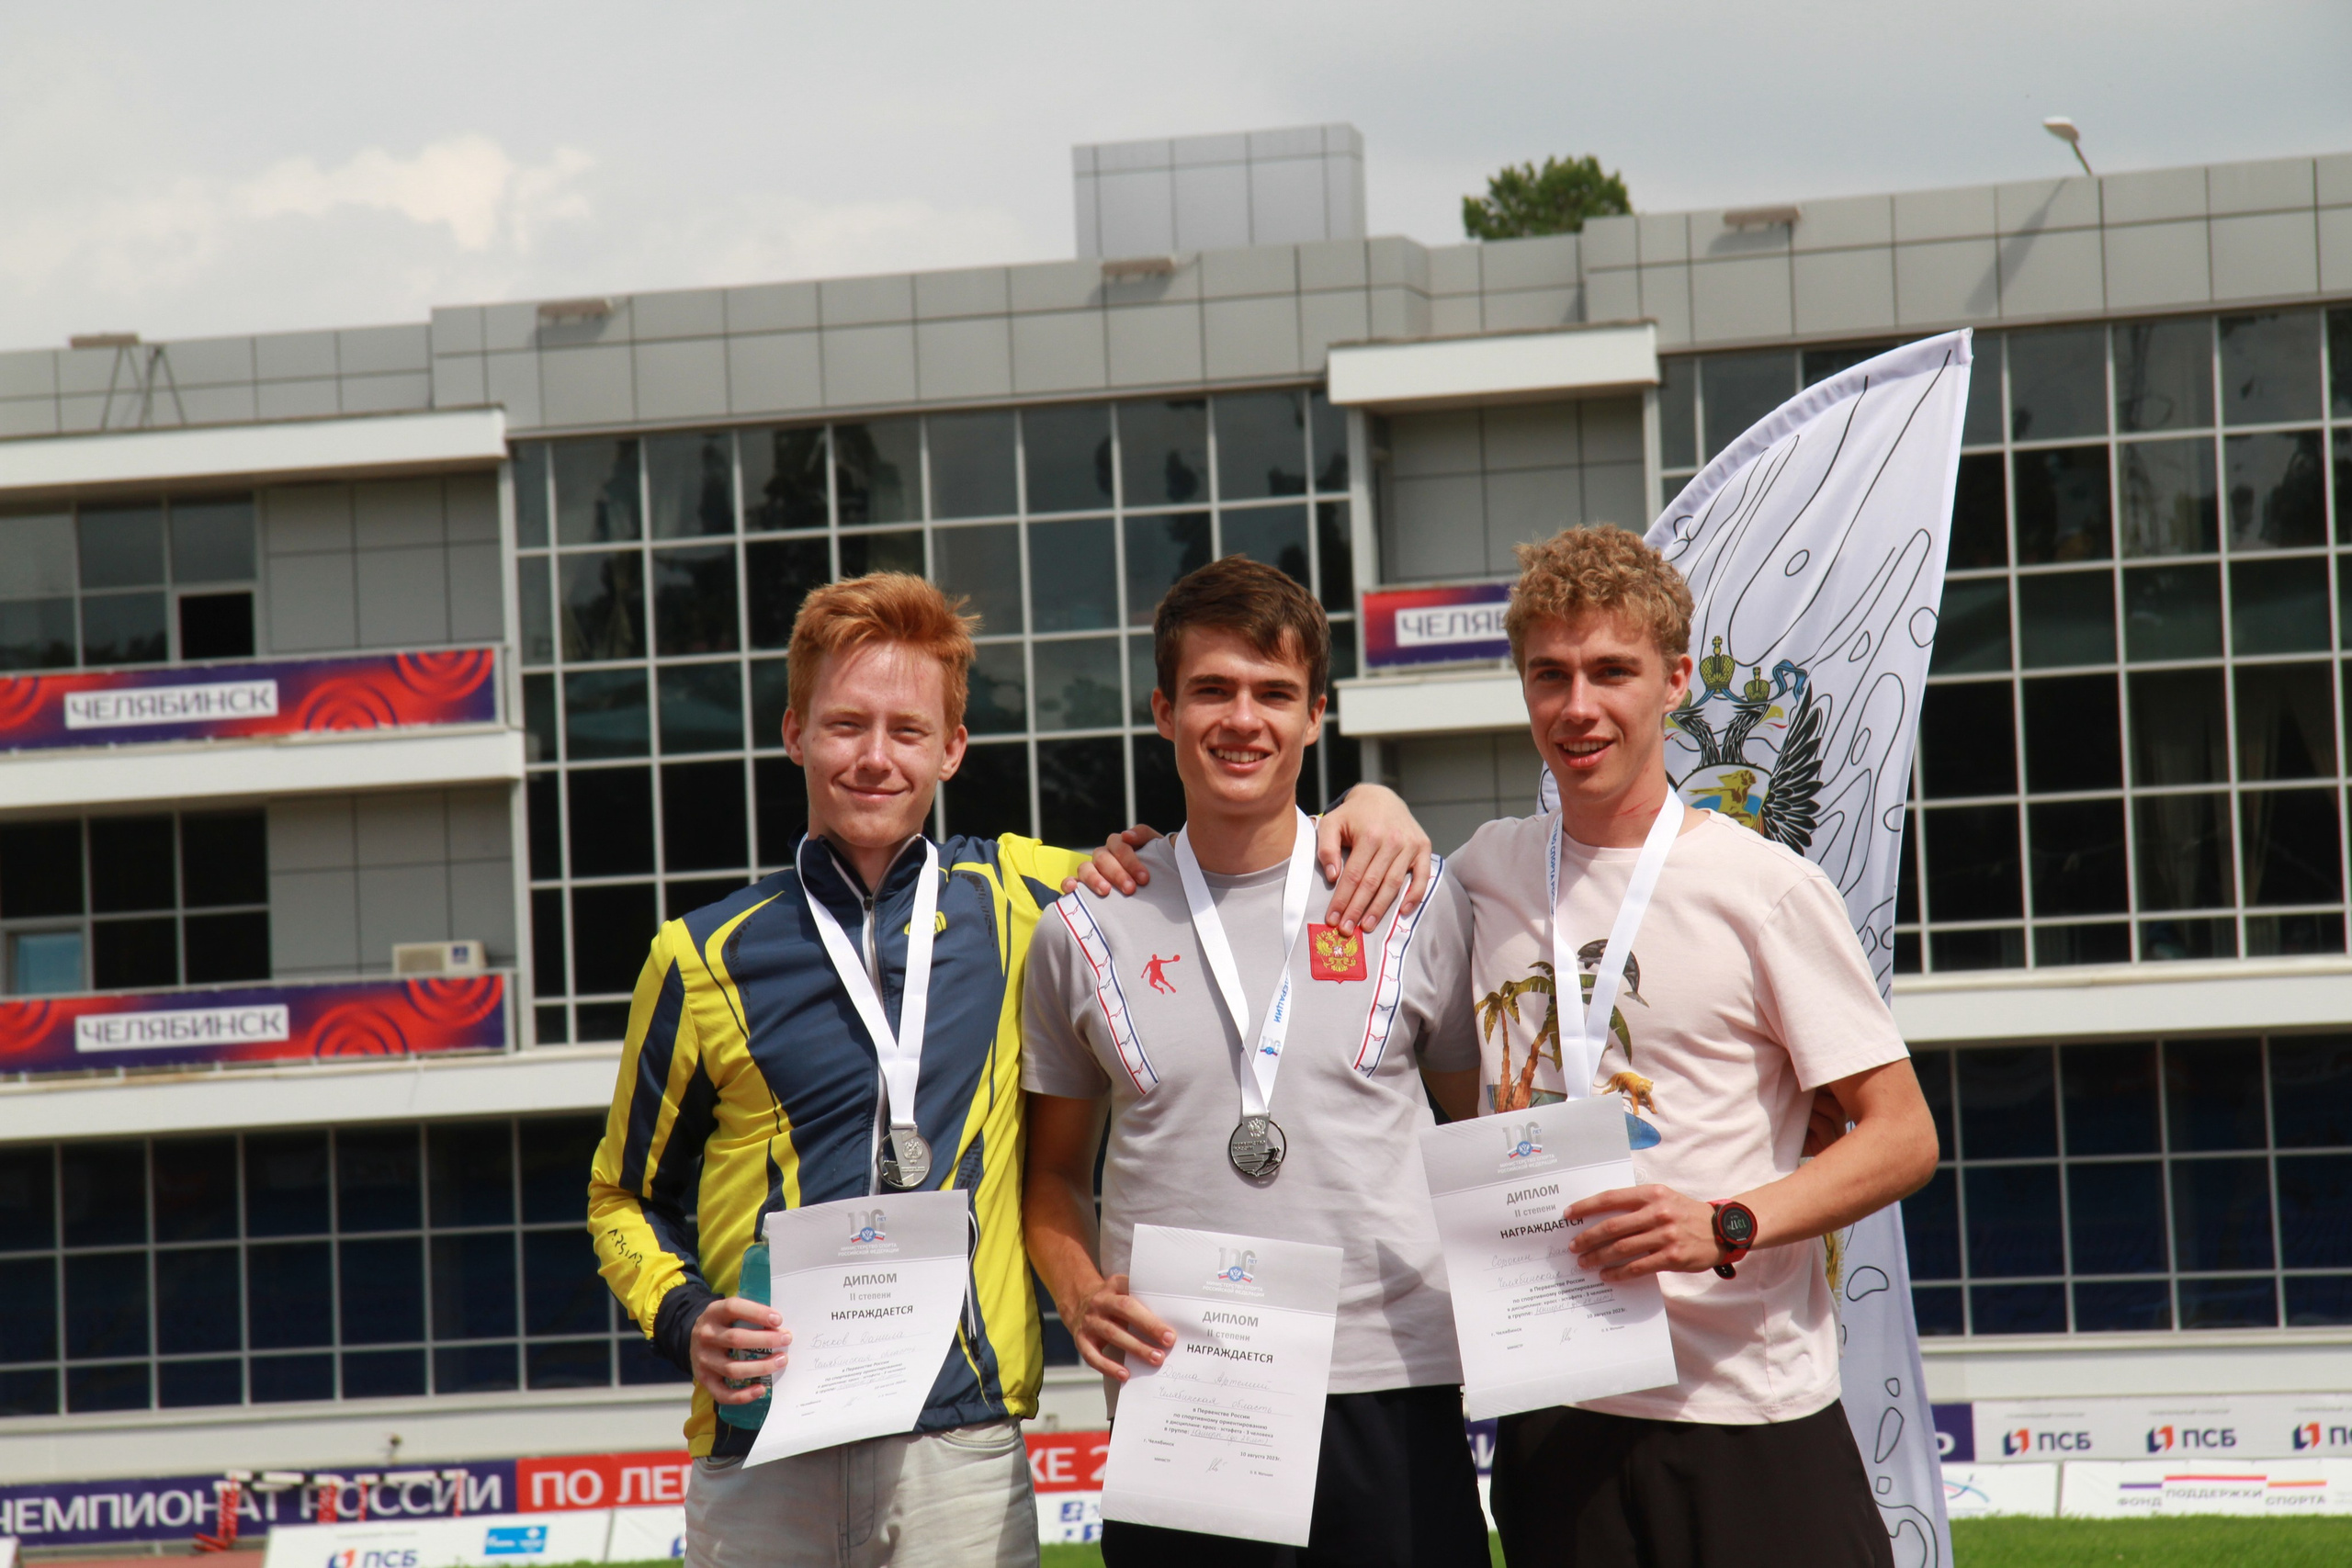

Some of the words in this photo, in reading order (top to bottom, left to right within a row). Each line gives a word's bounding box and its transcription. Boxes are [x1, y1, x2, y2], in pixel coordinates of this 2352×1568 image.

[70, 684, 273, 721] ЧЕЛЯБИНСК
[82, 1010, 284, 1044] ЧЕЛЯБИНСК
[1507, 1184, 1560, 1205] ДИПЛОМ
[1522, 1204, 1556, 1216] степени
[1499, 1218, 1584, 1239] НАГРАЖДАЕТСЯ
[843, 1273, 898, 1288] ДИПЛОМ
[858, 1292, 891, 1301] степени
[831, 1304, 913, 1321] НАГРАЖДАЕТСЯ
[1203, 1311, 1259, 1327] ДИПЛОМ
[1216, 1331, 1250, 1342] степени
[1187, 1343, 1274, 1364] НАГРАЖДАЕТСЯ
[1197, 1407, 1229, 1417] Первенстве
[1182, 1415, 1218, 1425] спортивному
[1219, 1420, 1268, 1430] ориентированию
[2038, 1430, 2091, 1450] ПСБ
[2183, 1427, 2236, 1448] ПСБ
[531, 1468, 604, 1507] ПО
[2118, 1496, 2163, 1507] ФОНД
[2165, 1488, 2263, 1499] ПОДДЕРЖКИ
[2265, 1495, 2325, 1506] СПОРТА
